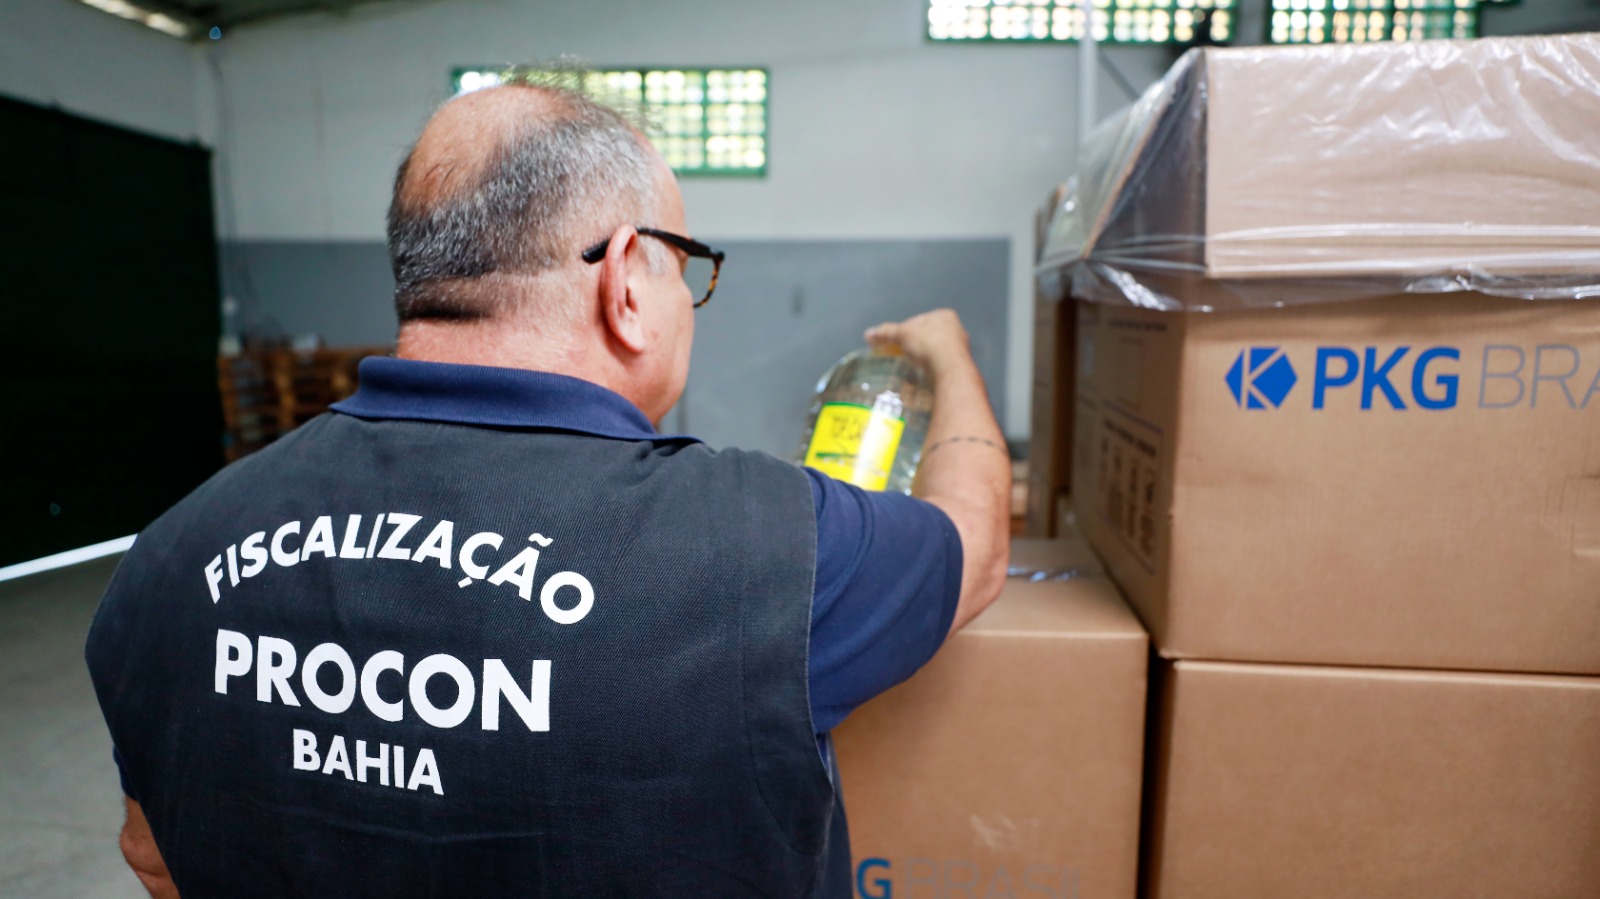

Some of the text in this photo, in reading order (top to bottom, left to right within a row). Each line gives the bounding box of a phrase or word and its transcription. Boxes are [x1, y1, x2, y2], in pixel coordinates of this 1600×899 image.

[1311, 344, 1600, 411] PKG BR
[204, 512, 595, 625] FISCALIZAÇÃO
[214, 628, 552, 732] PROCON
[293, 728, 445, 796] BAHIA
